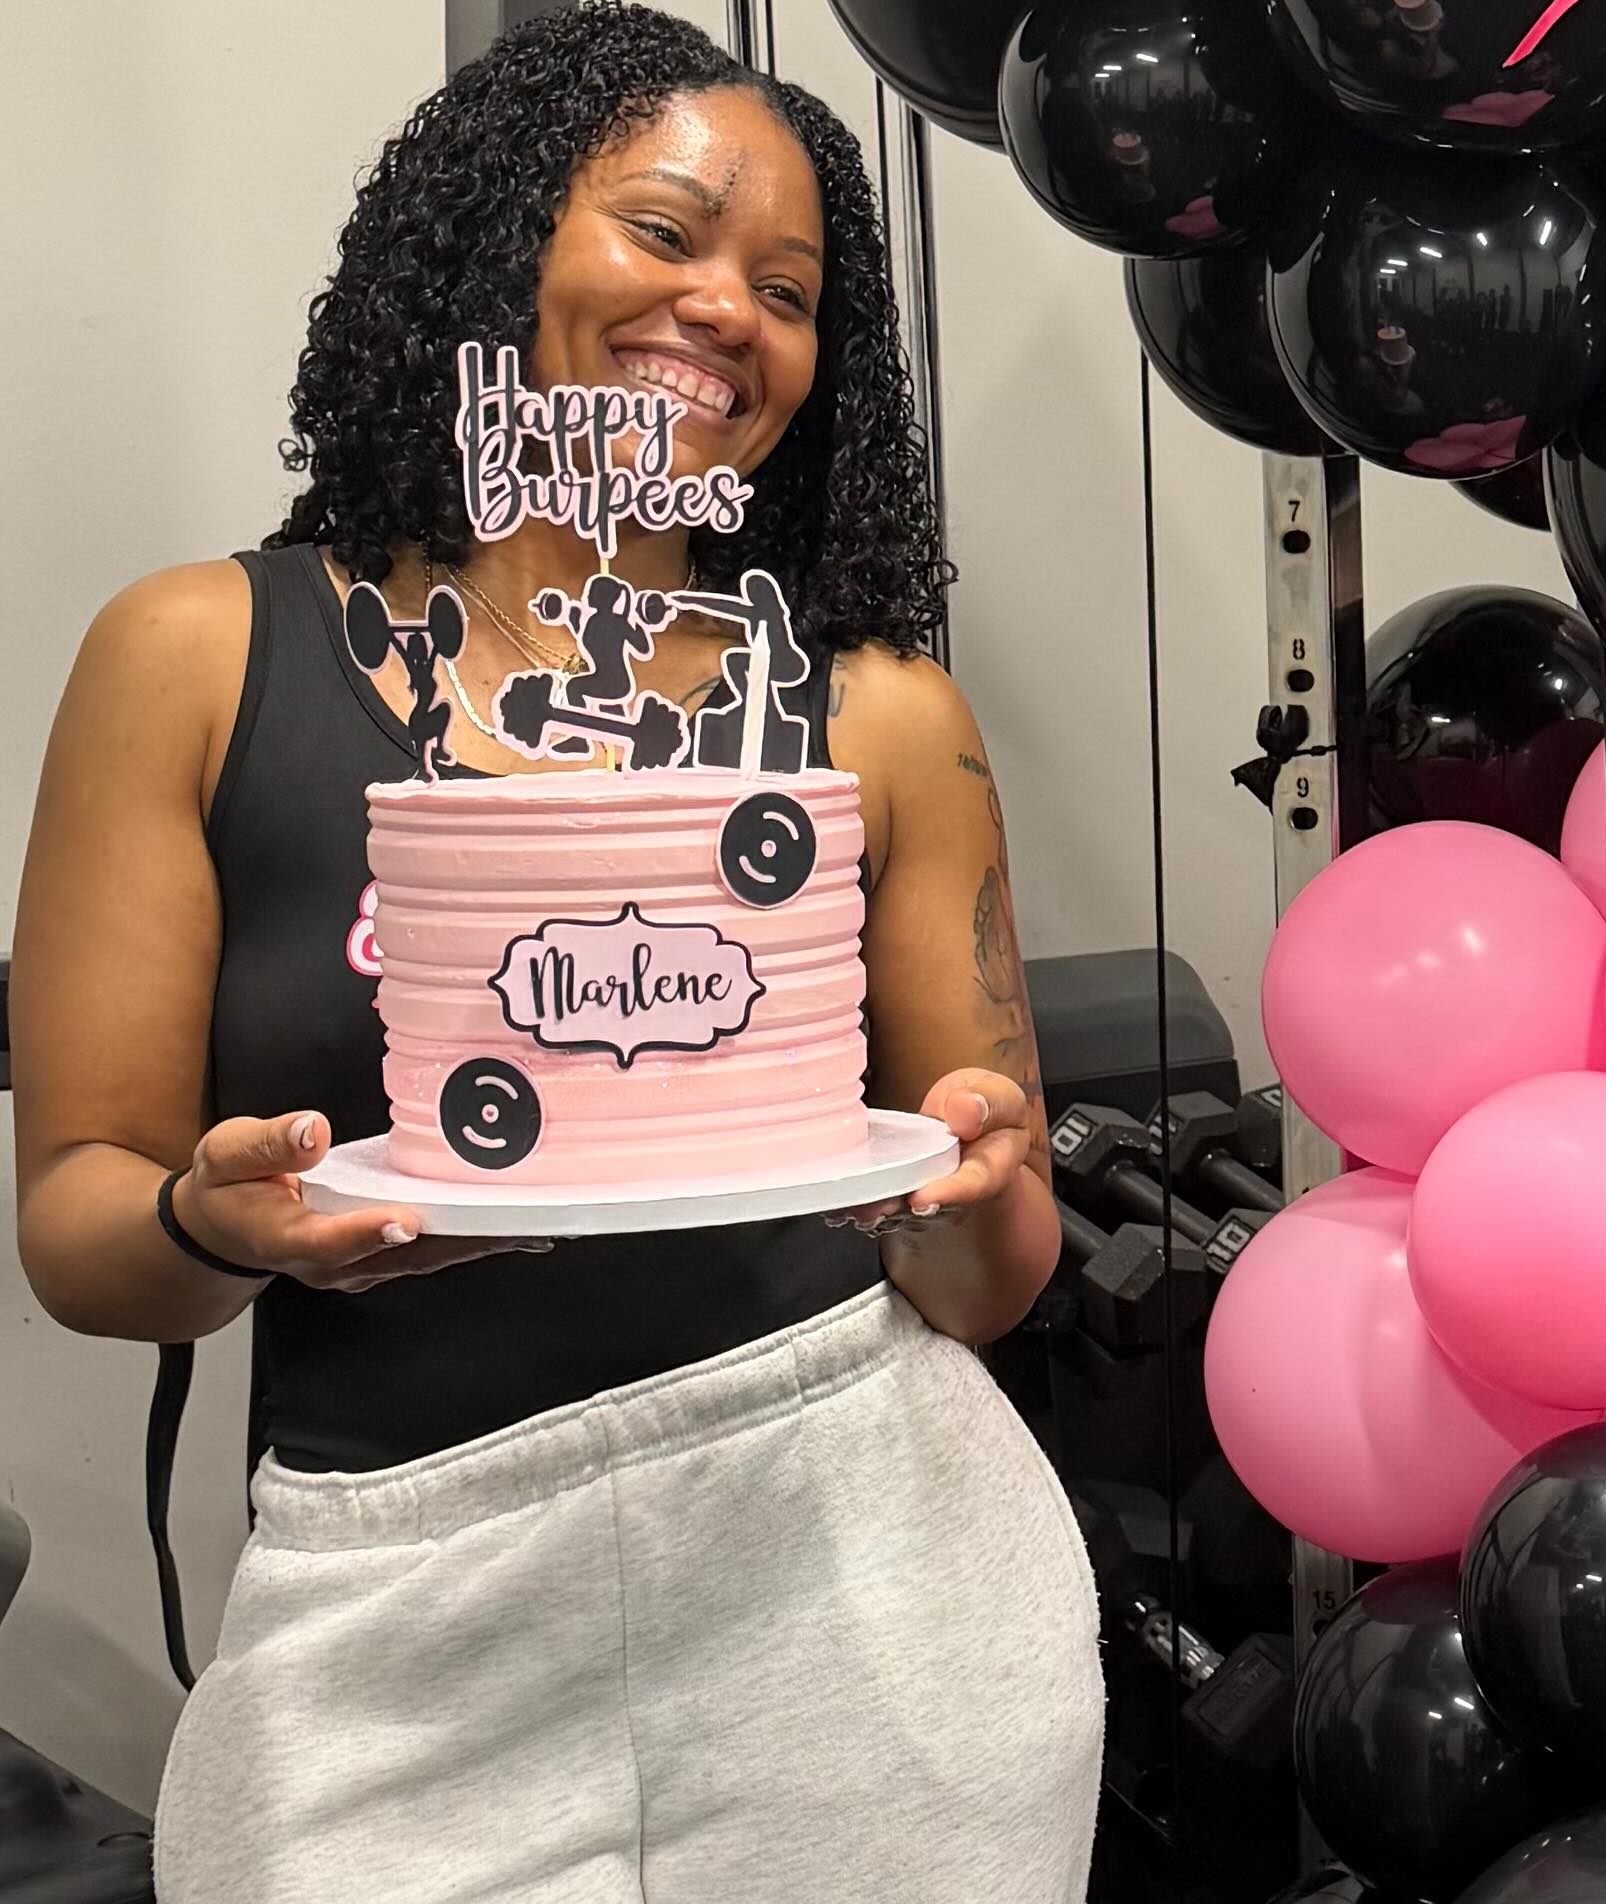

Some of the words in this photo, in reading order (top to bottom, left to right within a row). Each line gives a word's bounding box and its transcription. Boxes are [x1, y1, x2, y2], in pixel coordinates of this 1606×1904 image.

[462, 345, 684, 477] Happy
[467, 429, 753, 554] Burpees
[1288, 500, 1301, 523] 7
[1292, 638, 1306, 661] 8
[1296, 777, 1310, 799] 9
[529, 942, 733, 1022] Marlene
[1207, 1222, 1250, 1263] 10
